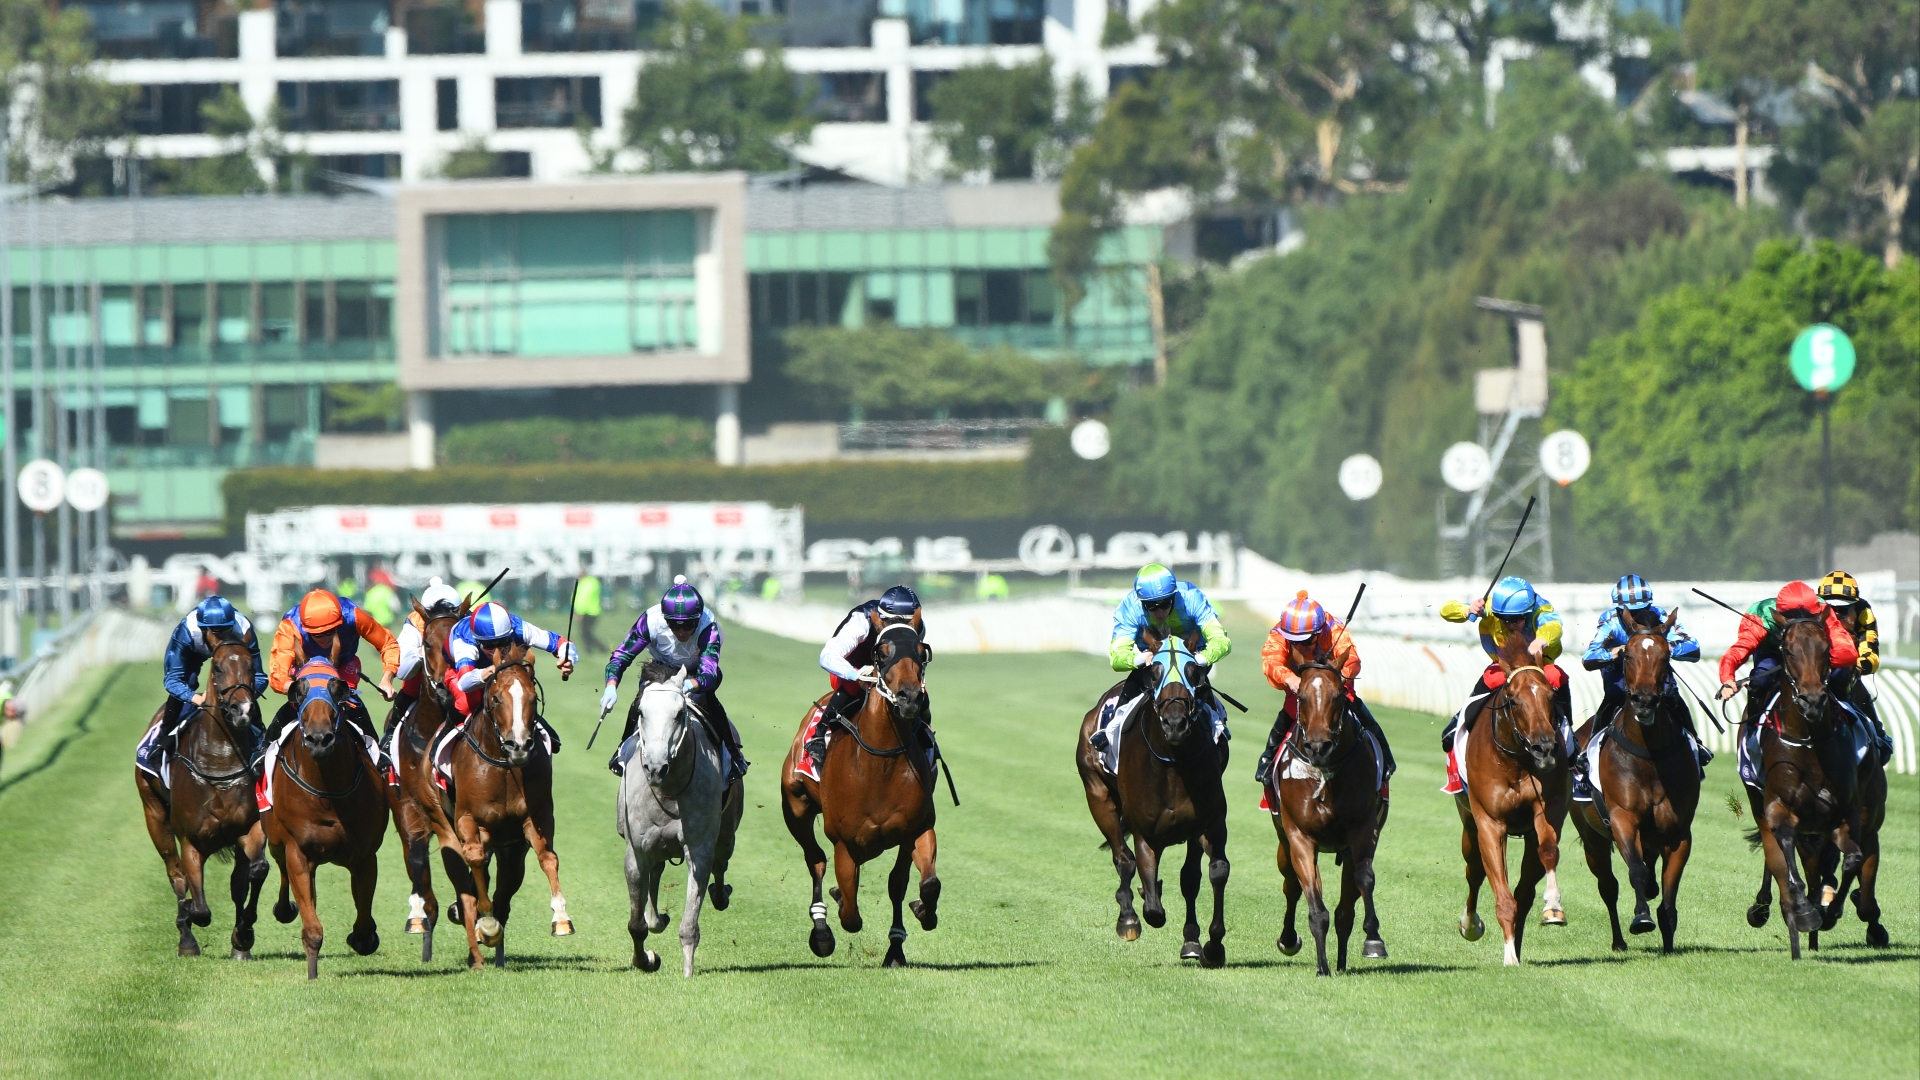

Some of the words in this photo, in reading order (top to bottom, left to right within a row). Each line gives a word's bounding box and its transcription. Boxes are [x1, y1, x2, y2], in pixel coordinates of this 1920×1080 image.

[1810, 328, 1835, 365] 6
[1557, 440, 1575, 471] 8
[33, 468, 50, 501] 8
[806, 536, 972, 569] EXUS
